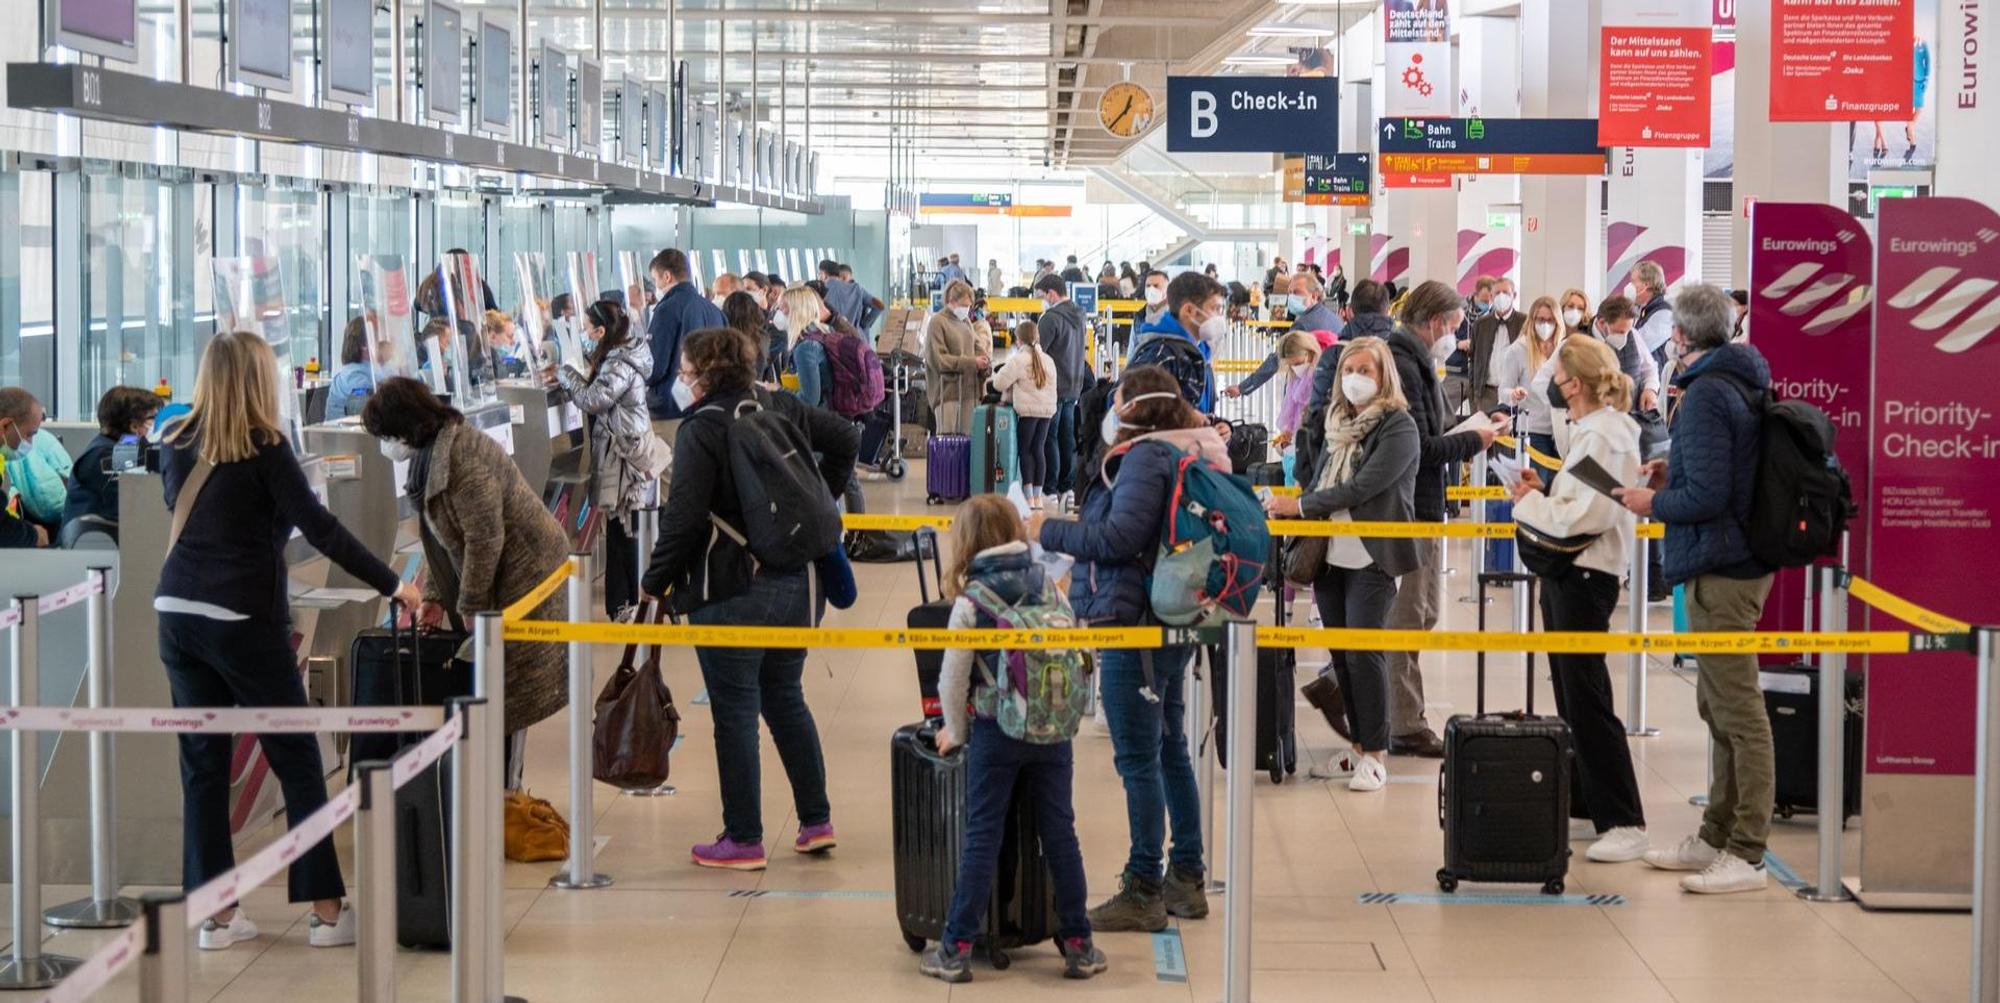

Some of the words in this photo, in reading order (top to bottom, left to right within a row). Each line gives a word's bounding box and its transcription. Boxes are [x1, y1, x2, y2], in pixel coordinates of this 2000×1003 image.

[1390, 8, 1443, 19] Deutschland
[1390, 19, 1411, 28] zählt
[1413, 19, 1427, 28] auf
[1610, 36, 1627, 46] Der
[1629, 36, 1682, 46] Mittelstand
[1610, 47, 1633, 57] kann
[1634, 47, 1649, 57] auf
[1651, 49, 1667, 58] uns
[1669, 48, 1702, 58] zählen.
[1958, 3, 1978, 109] Eurowi
[83, 71, 101, 105] B01
[1841, 101, 1900, 112] Finanzgruppe
[1190, 90, 1219, 138] B
[1231, 91, 1317, 110] Check-in
[1427, 124, 1452, 135] Bahn
[1654, 131, 1700, 141] Finanzgruppe
[1427, 138, 1457, 149] Trains
[1333, 176, 1347, 184] Bahn
[1762, 237, 1837, 254] Eurowings
[1890, 237, 1977, 256] Eurowings
[1769, 377, 1849, 404] riority-
[1884, 400, 1992, 431] Priority-
[504, 625, 526, 636] Bonn
[528, 625, 560, 638] Airport
[1069, 633, 1089, 643] Bonn
[1092, 631, 1124, 644] Airport
[909, 632, 929, 644] Köln
[931, 634, 952, 644] Bonn
[955, 633, 987, 646] Airport
[1273, 633, 1305, 646] Airport
[1677, 638, 1698, 648] Bonn
[1700, 637, 1732, 650] Airport
[1815, 638, 1836, 648] Bonn
[1838, 637, 1871, 650] Airport
[151, 716, 203, 729] Eurowings
[348, 716, 400, 729] Eurowings
[1877, 755, 1911, 765] Lufthansa
[1912, 756, 1936, 766] Group
